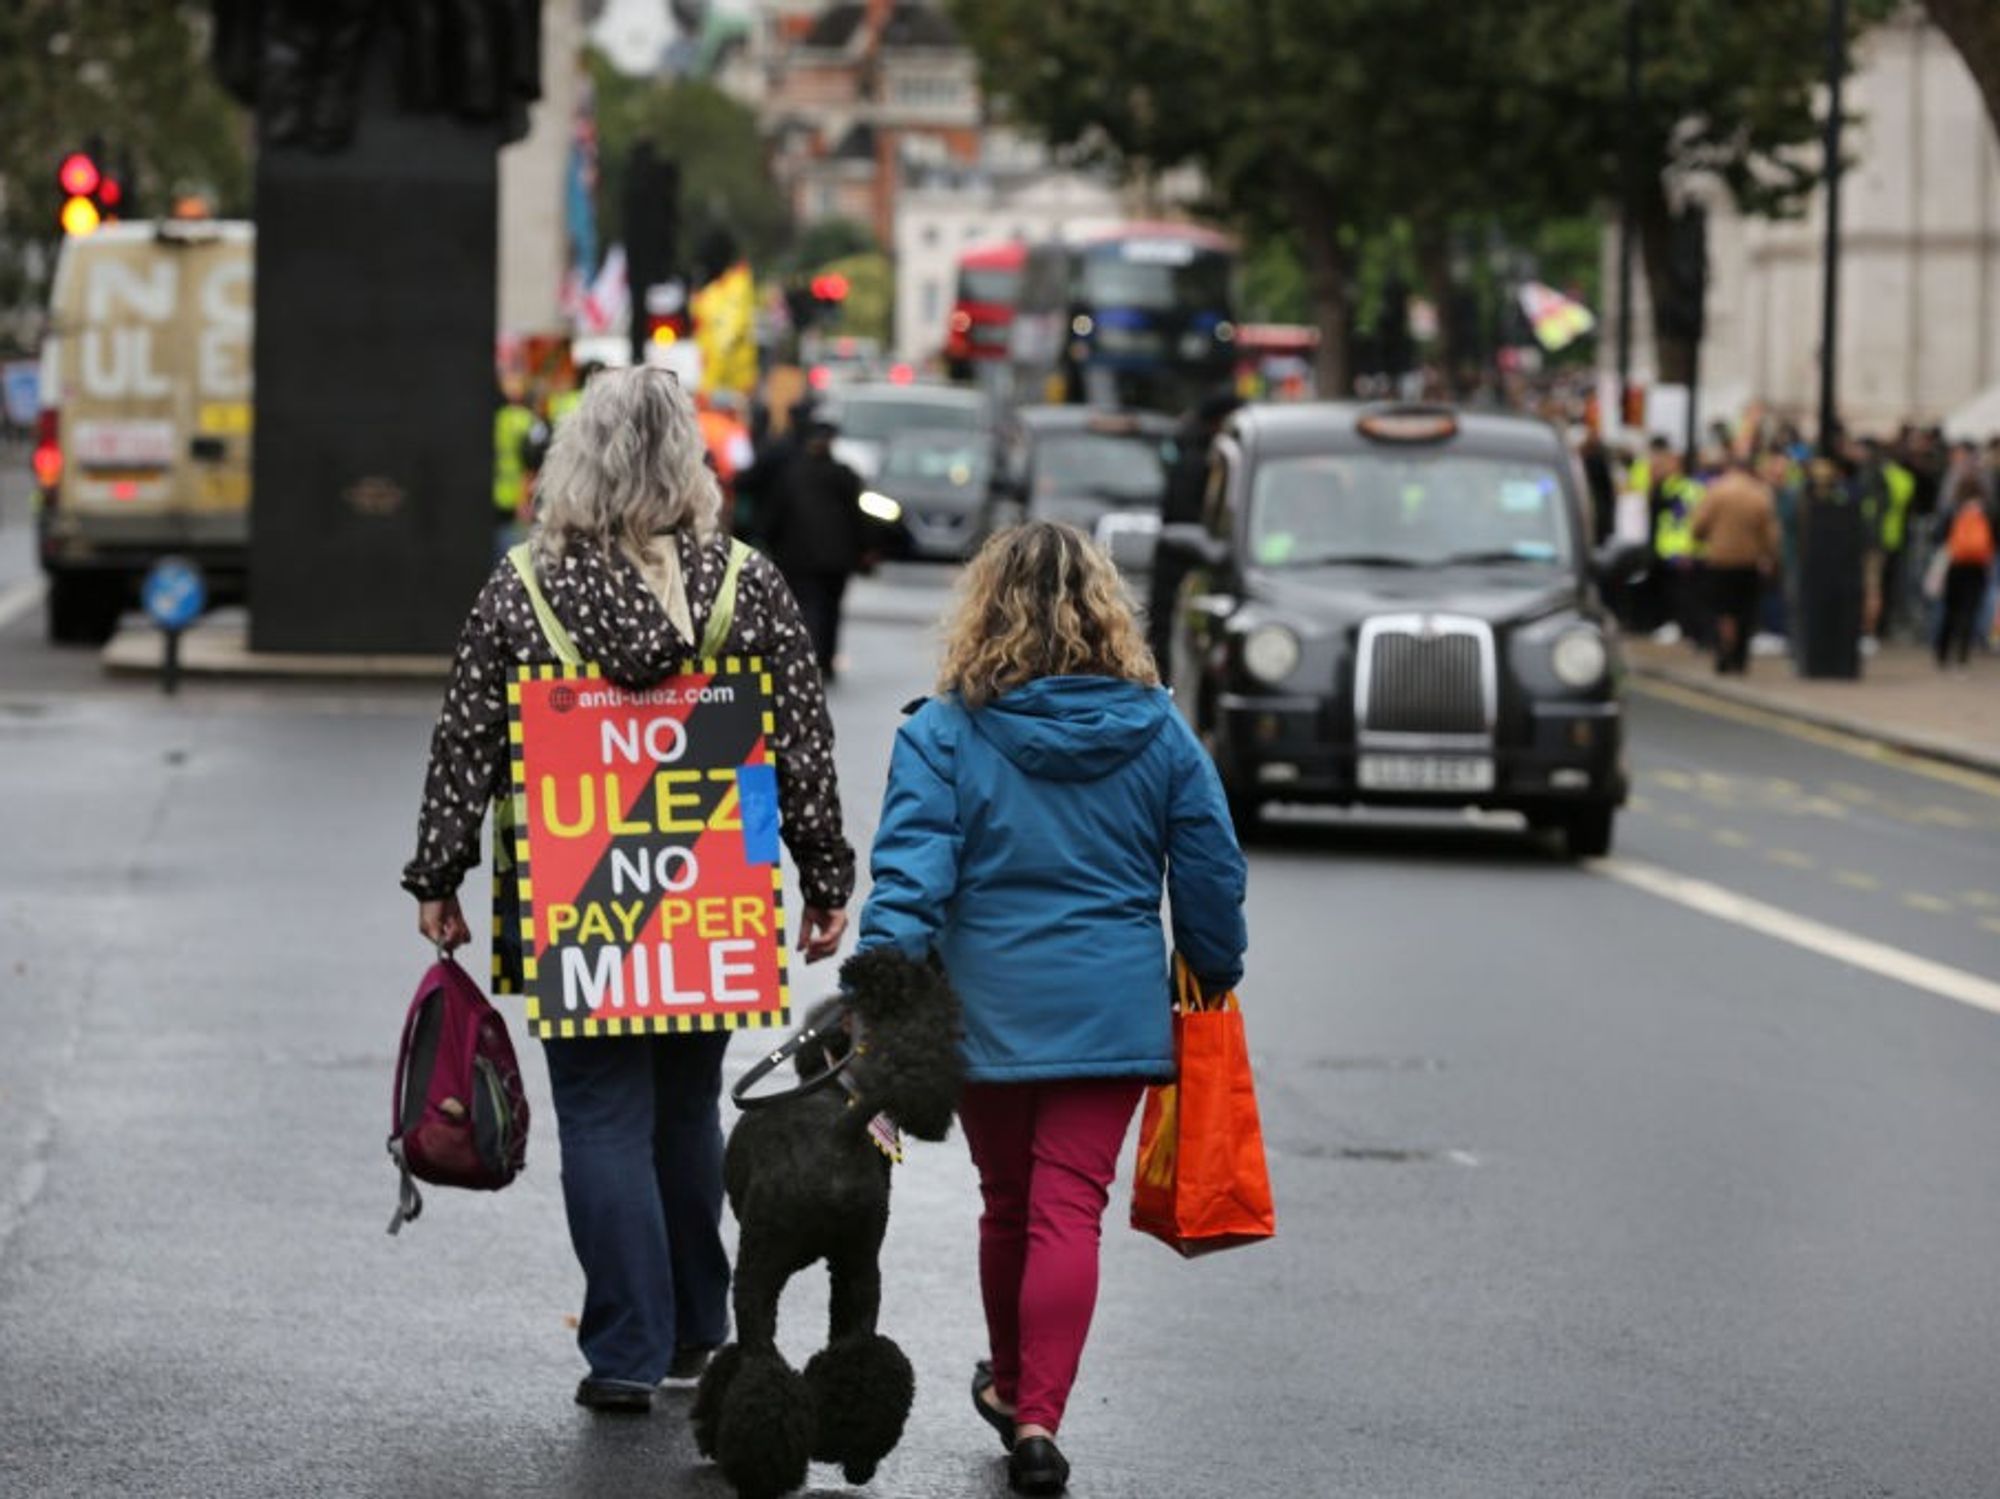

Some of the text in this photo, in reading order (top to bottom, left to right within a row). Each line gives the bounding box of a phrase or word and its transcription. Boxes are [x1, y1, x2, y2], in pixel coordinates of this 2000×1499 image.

[577, 684, 735, 710] anti-ulez.com
[600, 717, 688, 765] NO
[540, 768, 744, 838] ULEZ
[610, 846, 700, 895] NO
[547, 896, 767, 945] PAY PER
[560, 939, 761, 1011] MILE
